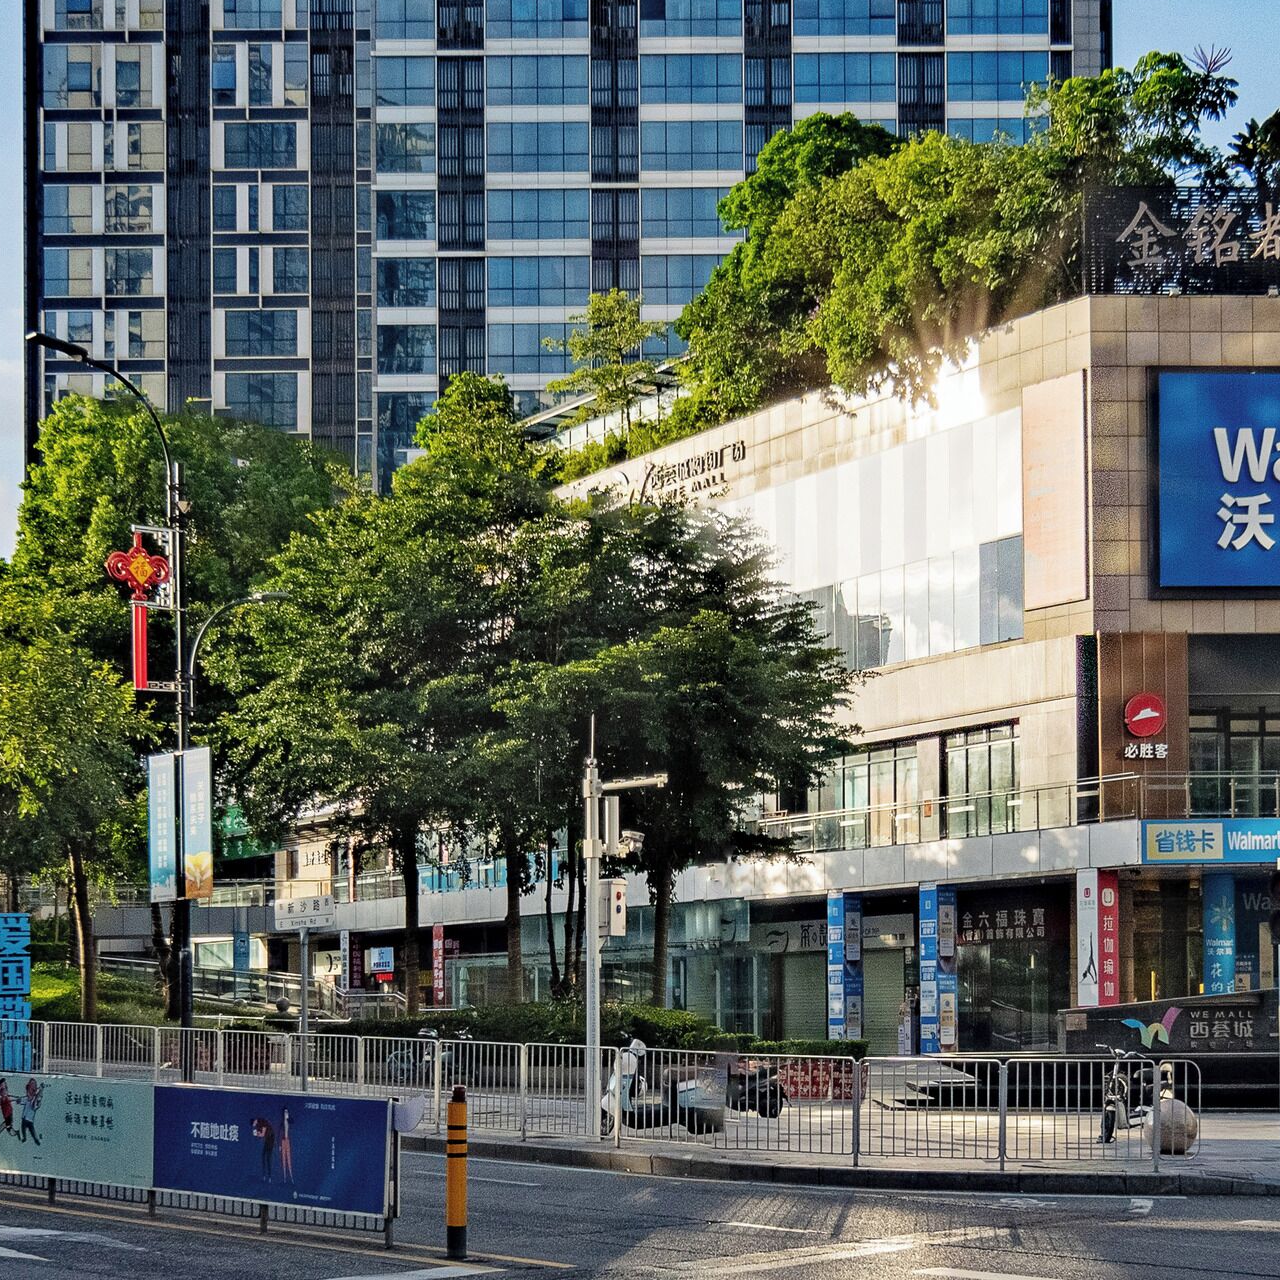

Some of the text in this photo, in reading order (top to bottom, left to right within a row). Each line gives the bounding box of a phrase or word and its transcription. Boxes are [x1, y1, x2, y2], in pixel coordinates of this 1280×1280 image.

[1124, 742, 1168, 759] 必胜客
[1155, 828, 1216, 854] 省钱卡
[962, 908, 1046, 929] 金六福珠寶
[1103, 914, 1115, 997] 拉伽瑜伽
[1190, 1010, 1253, 1019] WE MALL
[1189, 1020, 1254, 1039] 西荟城
[190, 1121, 239, 1142] 不随地吐痰
